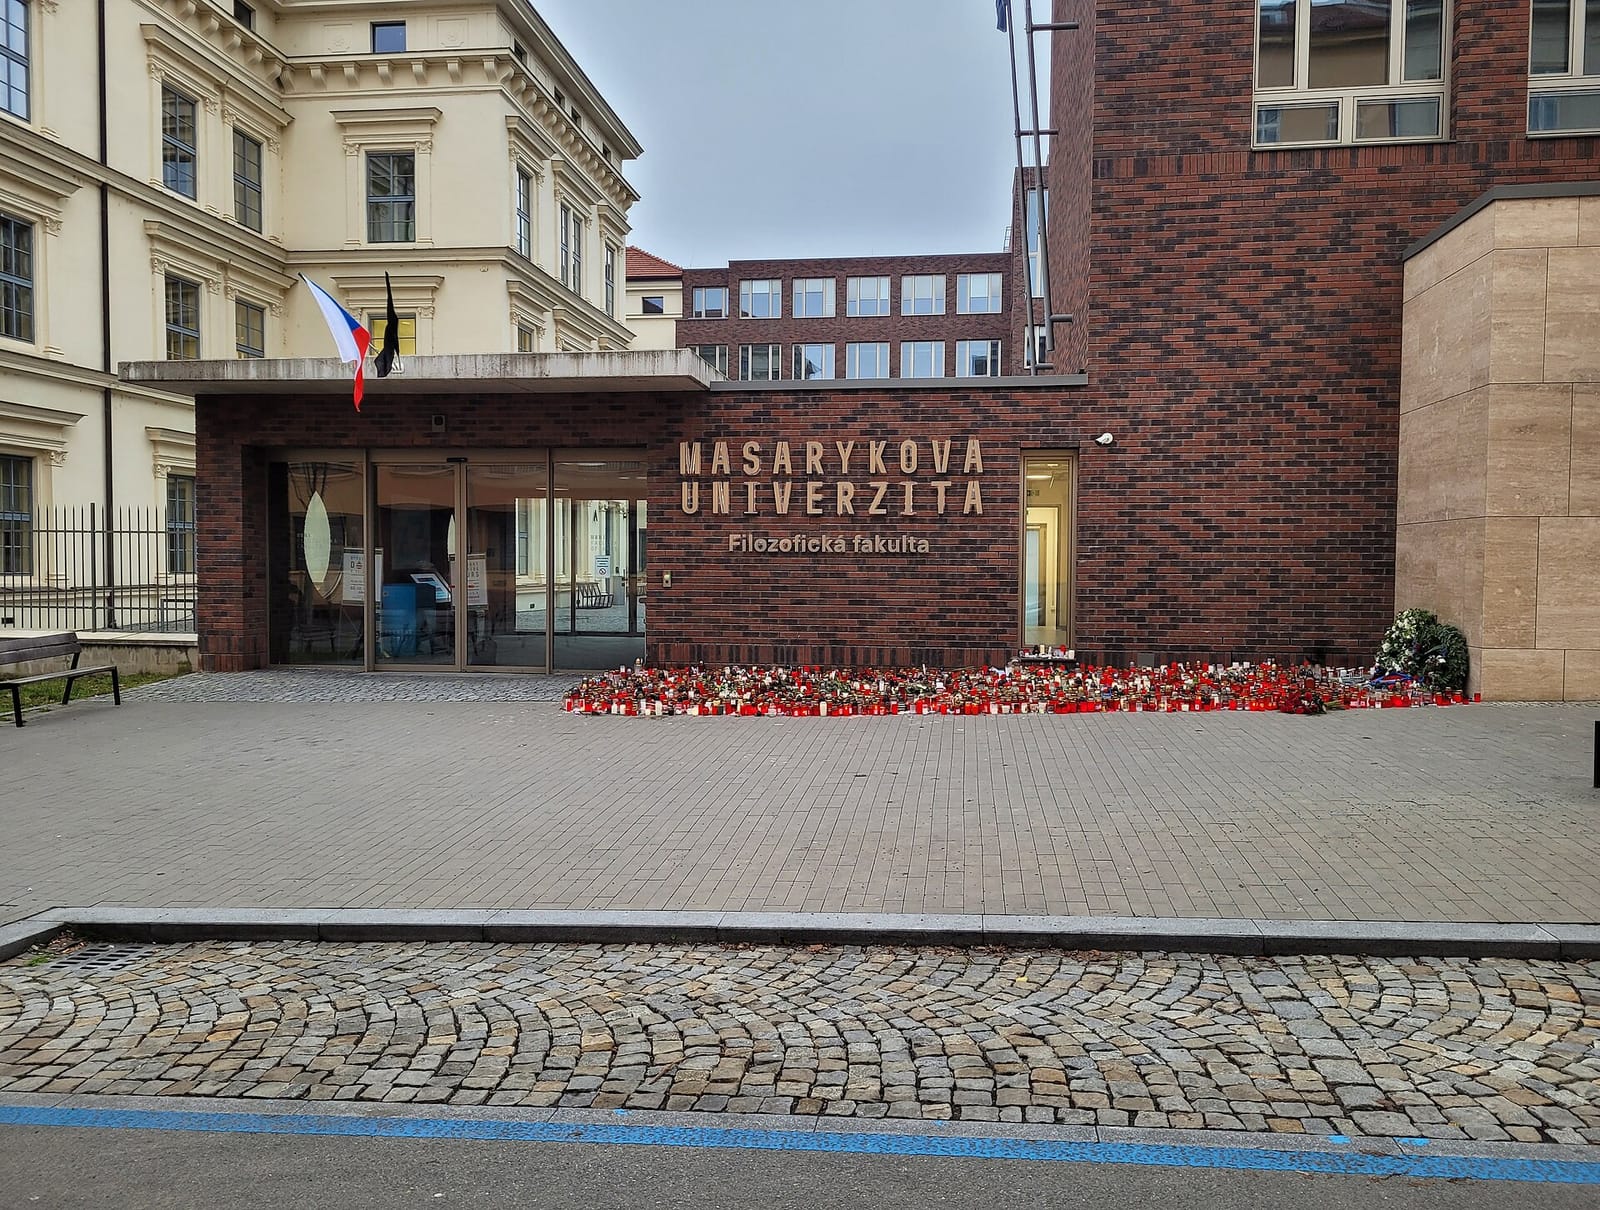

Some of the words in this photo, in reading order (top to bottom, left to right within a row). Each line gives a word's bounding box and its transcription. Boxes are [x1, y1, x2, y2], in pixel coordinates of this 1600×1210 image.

[679, 439, 984, 475] MASARYKOVA
[681, 480, 984, 516] UNIVERZITA
[728, 533, 846, 553] Filozofická
[853, 533, 930, 553] fakulta
